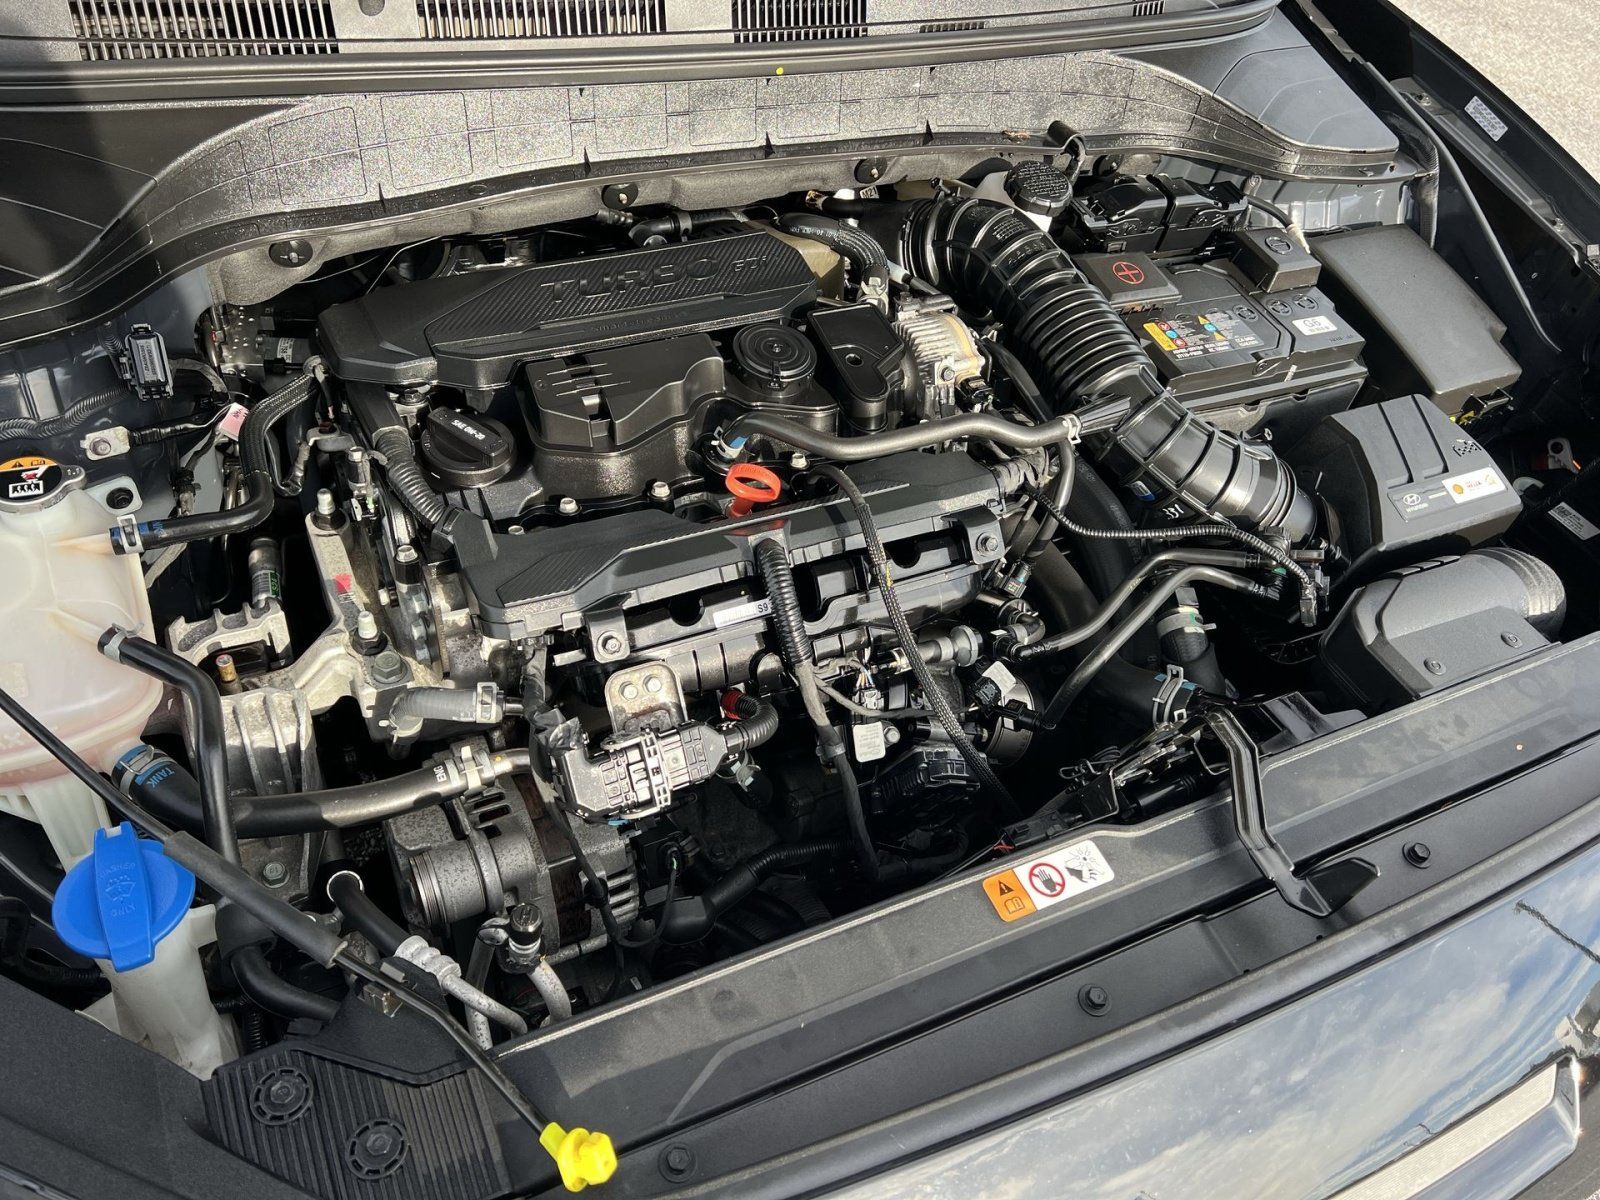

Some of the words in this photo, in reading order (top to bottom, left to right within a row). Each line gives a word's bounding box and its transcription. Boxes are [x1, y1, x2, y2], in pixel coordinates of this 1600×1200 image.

[861, 186, 878, 198] M21
[540, 257, 719, 303] TURBO
[1302, 319, 1322, 328] G6
[451, 419, 468, 430] SAE
[463, 426, 486, 440] 0W-20
[757, 602, 769, 613] S9
[146, 767, 175, 788] TANK
[433, 764, 447, 783] ENG
